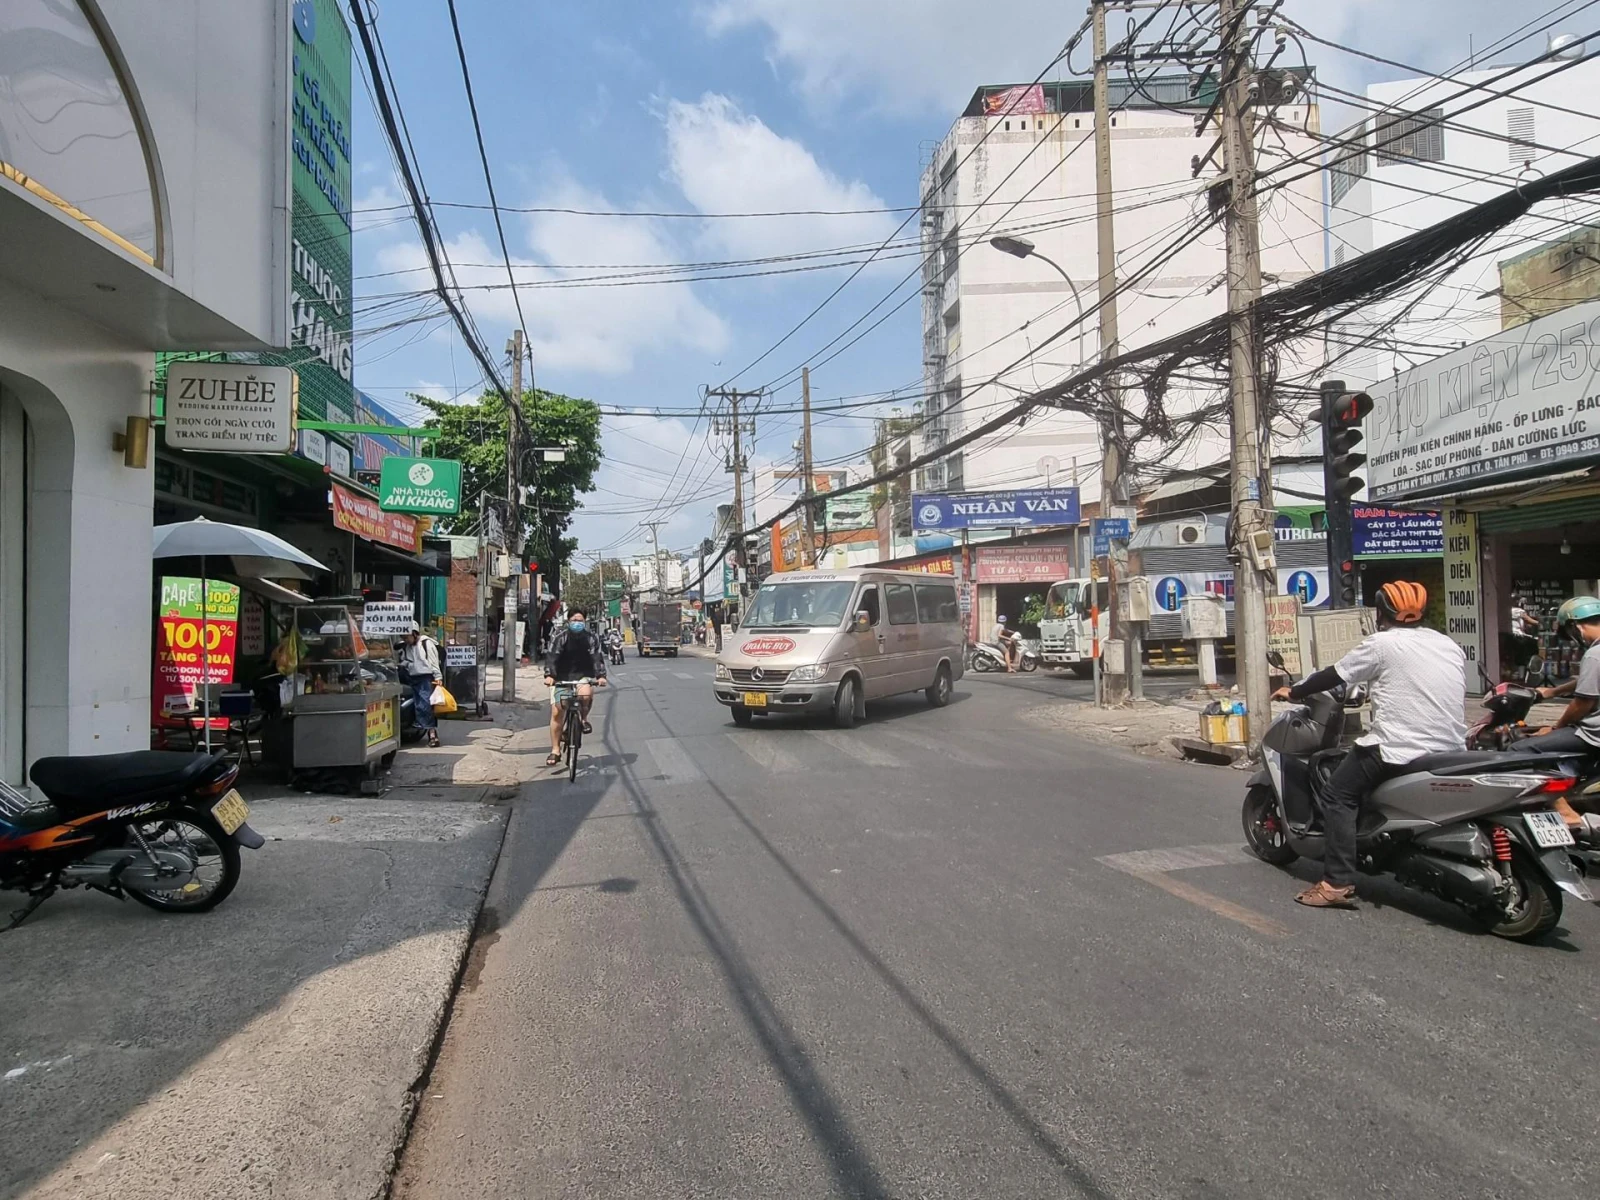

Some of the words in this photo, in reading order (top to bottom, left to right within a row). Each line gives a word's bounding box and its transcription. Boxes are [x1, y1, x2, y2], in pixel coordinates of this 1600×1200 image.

[293, 238, 342, 316] THUỐC
[1372, 378, 1429, 440] PHỤ
[1439, 345, 1519, 419] KIỆN
[175, 417, 201, 427] TRỌN
[203, 417, 221, 427] GÓI
[224, 419, 248, 429] NGÀY
[251, 419, 276, 430] CƯỚI
[175, 430, 208, 440] TRANG
[255, 433, 278, 443] TIỆC
[1370, 450, 1400, 468] CHUYÊN
[1401, 444, 1418, 458] PHỤ
[1420, 437, 1441, 453] KIỆN
[1443, 429, 1472, 447] CHÍNH
[1513, 411, 1528, 428] ỐP
[1532, 404, 1564, 423] LƯNG
[1393, 465, 1408, 477] LOA
[1415, 458, 1433, 472] SẠC
[1435, 452, 1448, 467] DỰ
[1449, 445, 1482, 463] PHÒNG
[1492, 436, 1514, 453] DÁN
[1518, 427, 1558, 447] CƯỜNG
[1562, 420, 1587, 437] LỰC
[1398, 481, 1410, 491] TÂN
[1420, 474, 1432, 486] TÂN
[1494, 457, 1510, 469] TÂN
[1555, 442, 1579, 456] 0949
[1580, 437, 1600, 450] 383
[392, 487, 413, 496] NHÀ
[415, 487, 448, 498] THUỐC
[383, 495, 405, 505] AN
[406, 496, 455, 509] KHANG
[952, 499, 1015, 515] NHÂN
[1023, 496, 1069, 511] VĂN
[1354, 508, 1385, 518] NAM
[1409, 530, 1426, 538] THỊT
[1382, 540, 1400, 549] BIỆT
[1421, 539, 1438, 547] THỊT
[1449, 533, 1470, 555] KIỆN
[1449, 590, 1475, 610] THOẠI
[366, 604, 395, 612] BÁNH
[398, 604, 411, 612] MÌ
[366, 614, 383, 622] XÔI
[1449, 614, 1477, 634] CHÍNH
[1268, 619, 1295, 635] 258
[163, 622, 234, 650] 100%
[773, 641, 794, 651] HUY
[160, 651, 198, 664] TẶNG
[180, 666, 201, 674] ĐƠN
[166, 674, 177, 682] TỪ
[106, 802, 157, 820] Wave
